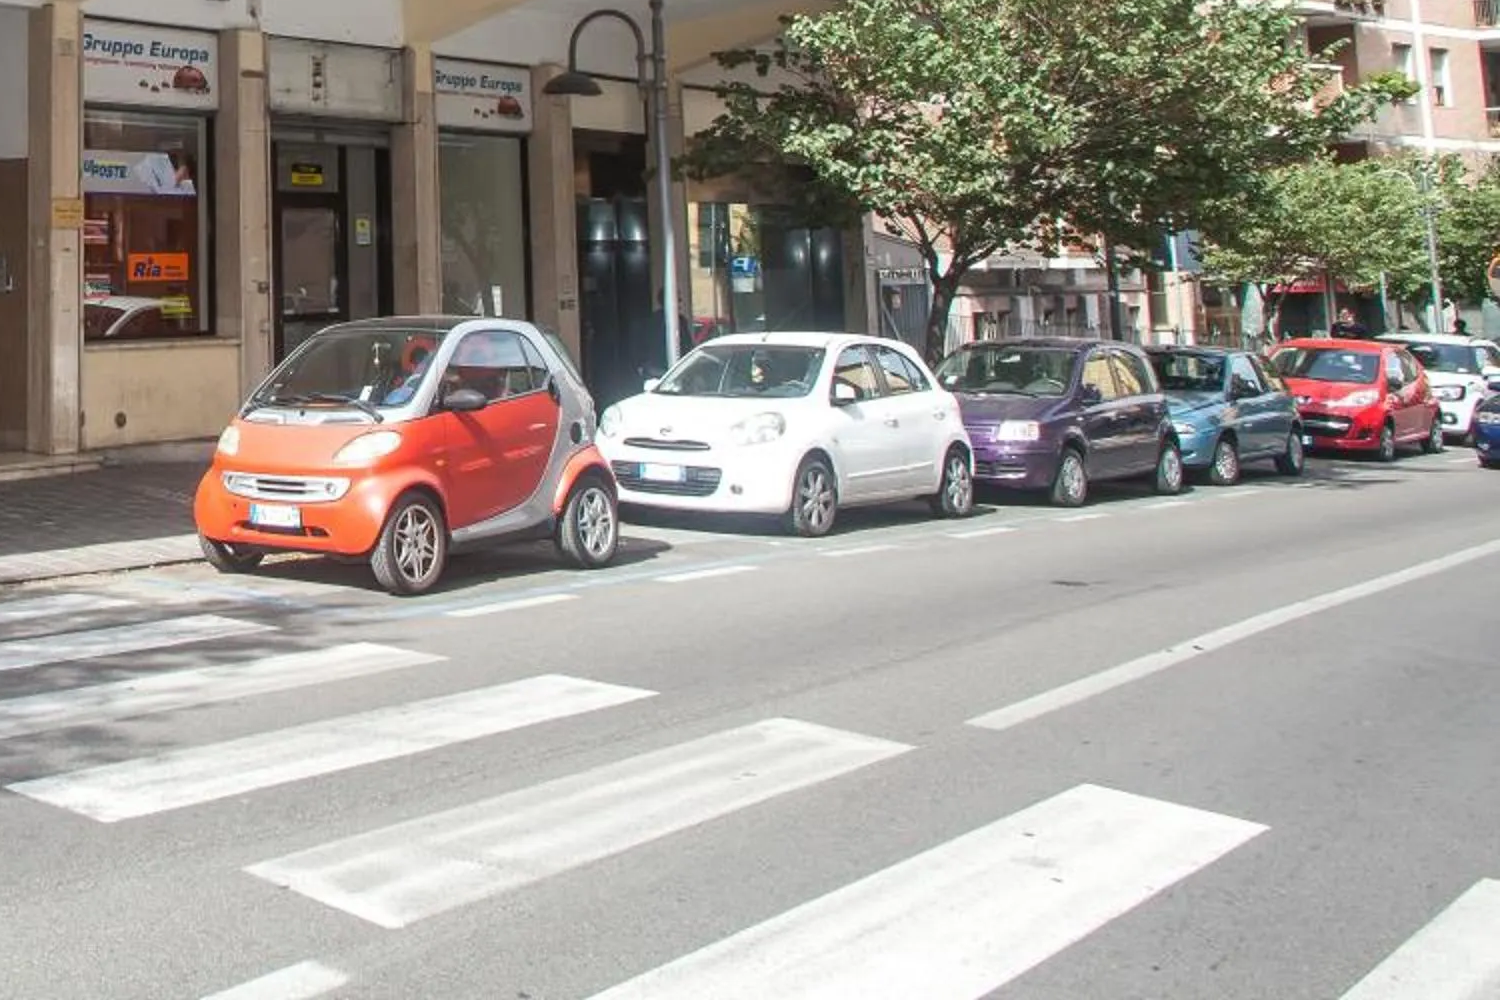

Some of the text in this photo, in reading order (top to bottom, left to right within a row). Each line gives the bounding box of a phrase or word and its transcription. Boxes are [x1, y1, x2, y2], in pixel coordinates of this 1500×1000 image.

[83, 33, 144, 58] Gruppo
[149, 41, 210, 64] Europa
[480, 75, 524, 95] Europa
[133, 256, 161, 278] Ria
